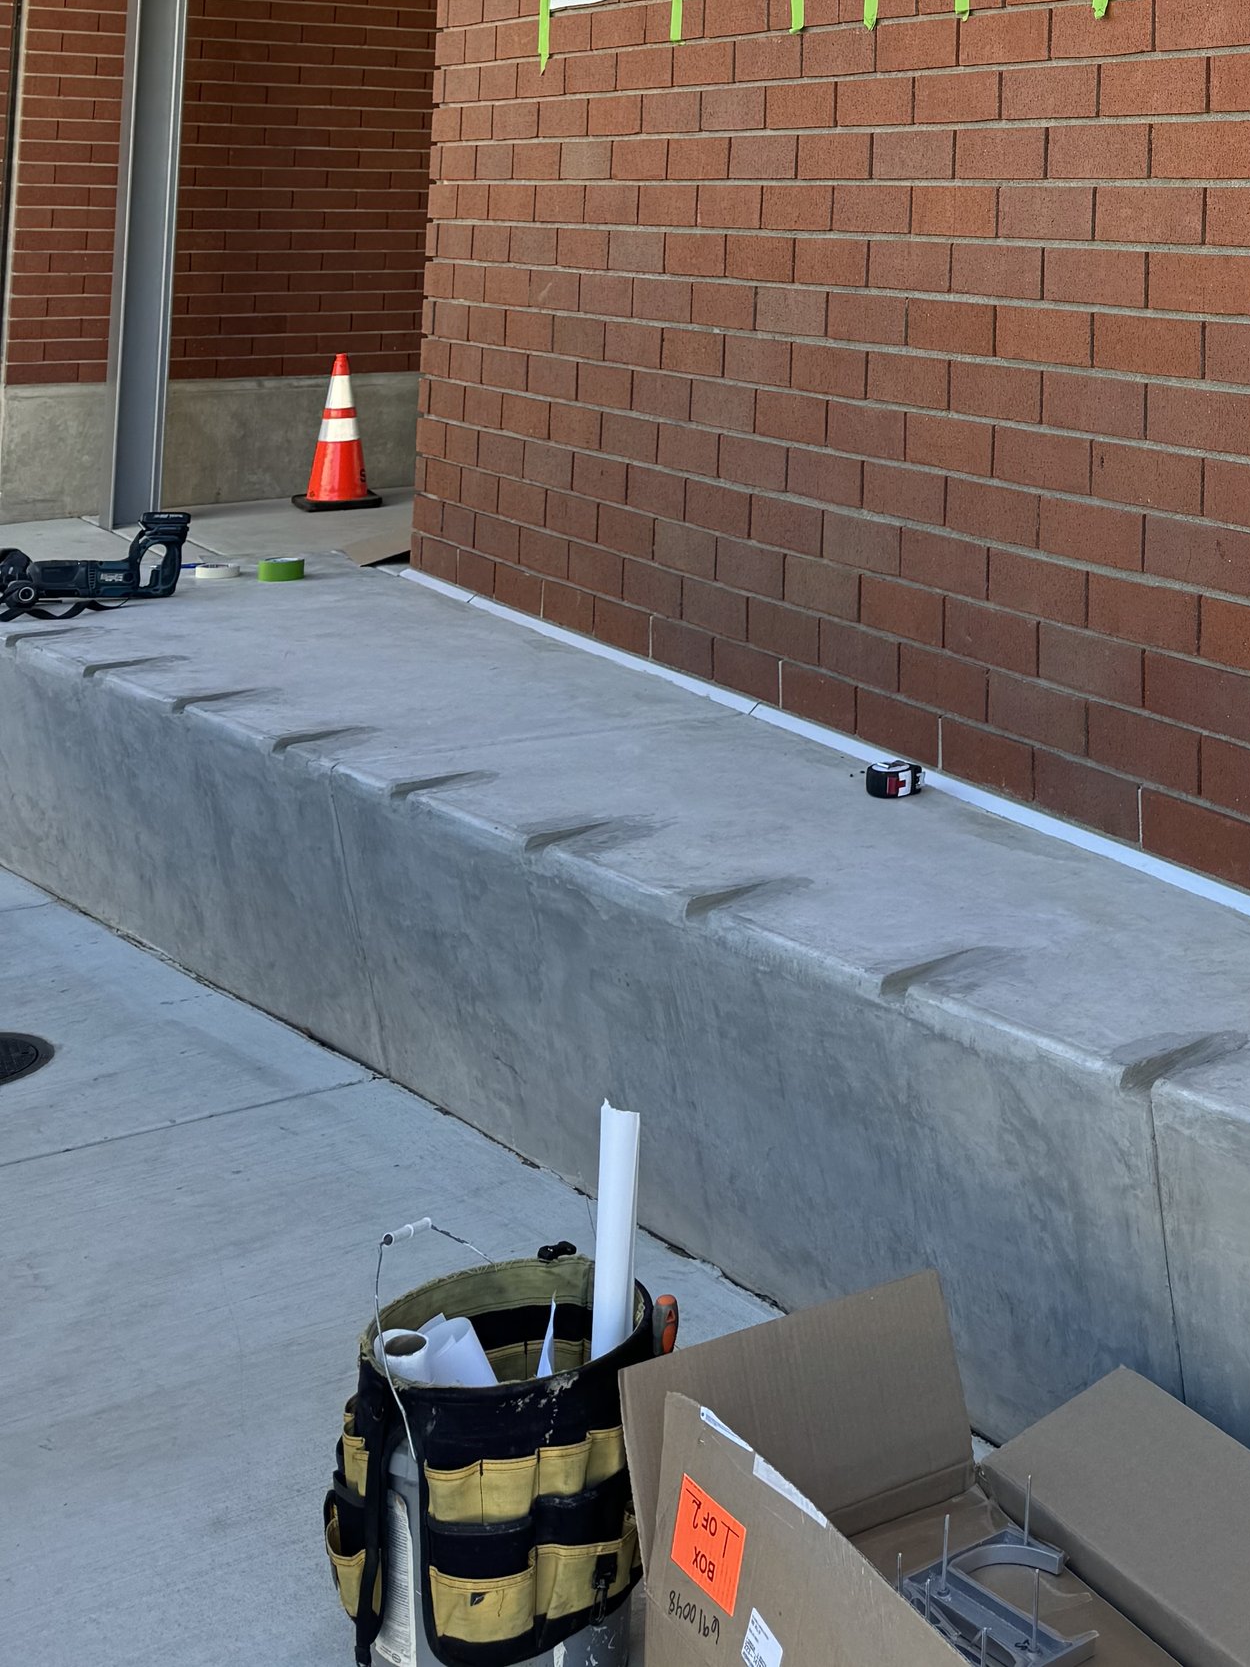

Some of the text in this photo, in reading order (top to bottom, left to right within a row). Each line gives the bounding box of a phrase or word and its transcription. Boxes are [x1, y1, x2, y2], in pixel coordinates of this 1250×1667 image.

[691, 1498, 702, 1530] 2
[701, 1511, 718, 1537] OF
[692, 1545, 716, 1583] BOX
[668, 1589, 721, 1646] 6910048
